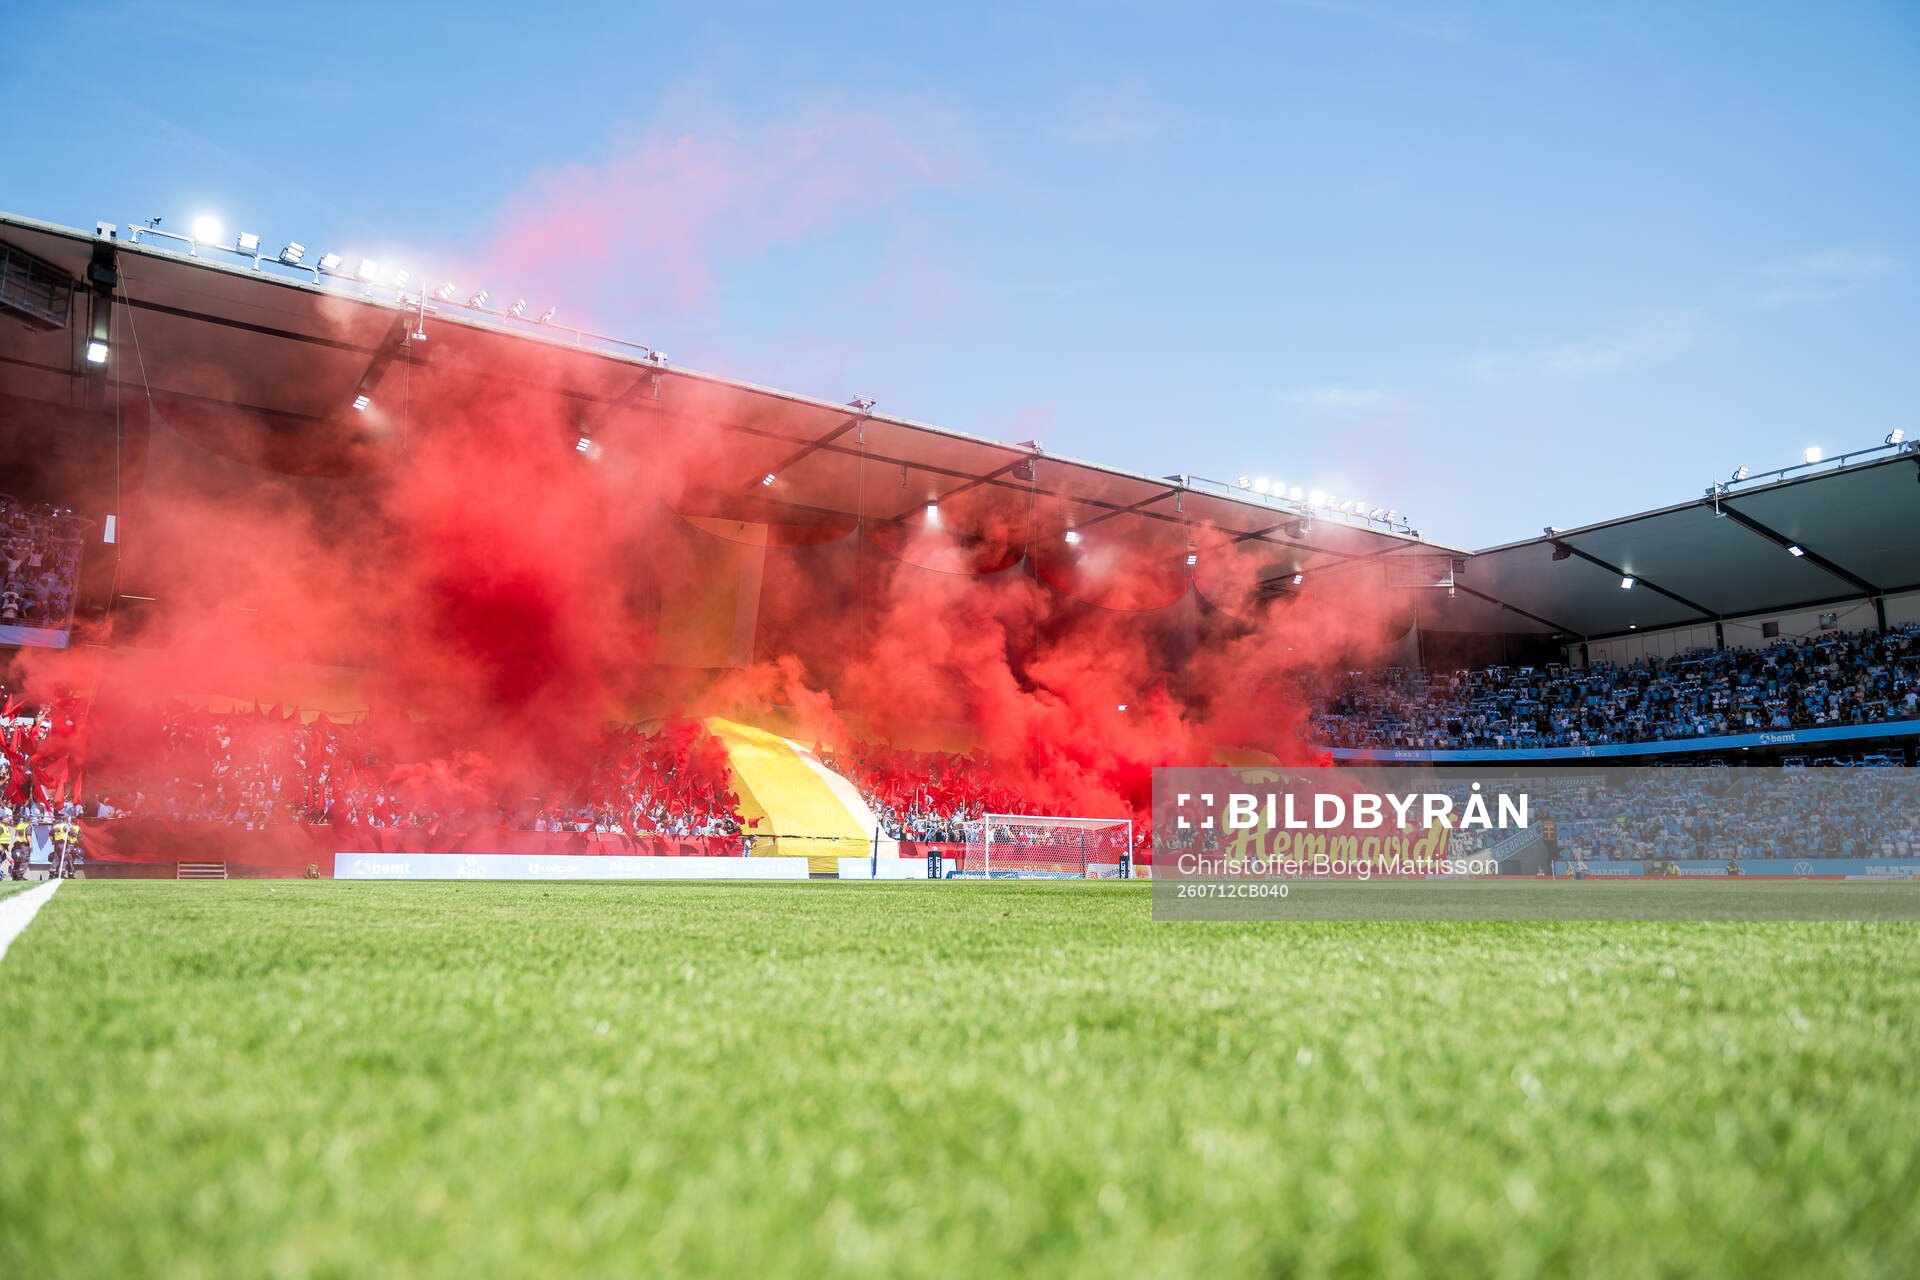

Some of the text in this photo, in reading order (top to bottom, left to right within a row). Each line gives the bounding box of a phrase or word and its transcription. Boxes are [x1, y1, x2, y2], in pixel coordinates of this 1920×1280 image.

[1771, 733, 1796, 743] bemt
[1501, 829, 1538, 859] FEBRUARI
[372, 861, 411, 874] bemt
